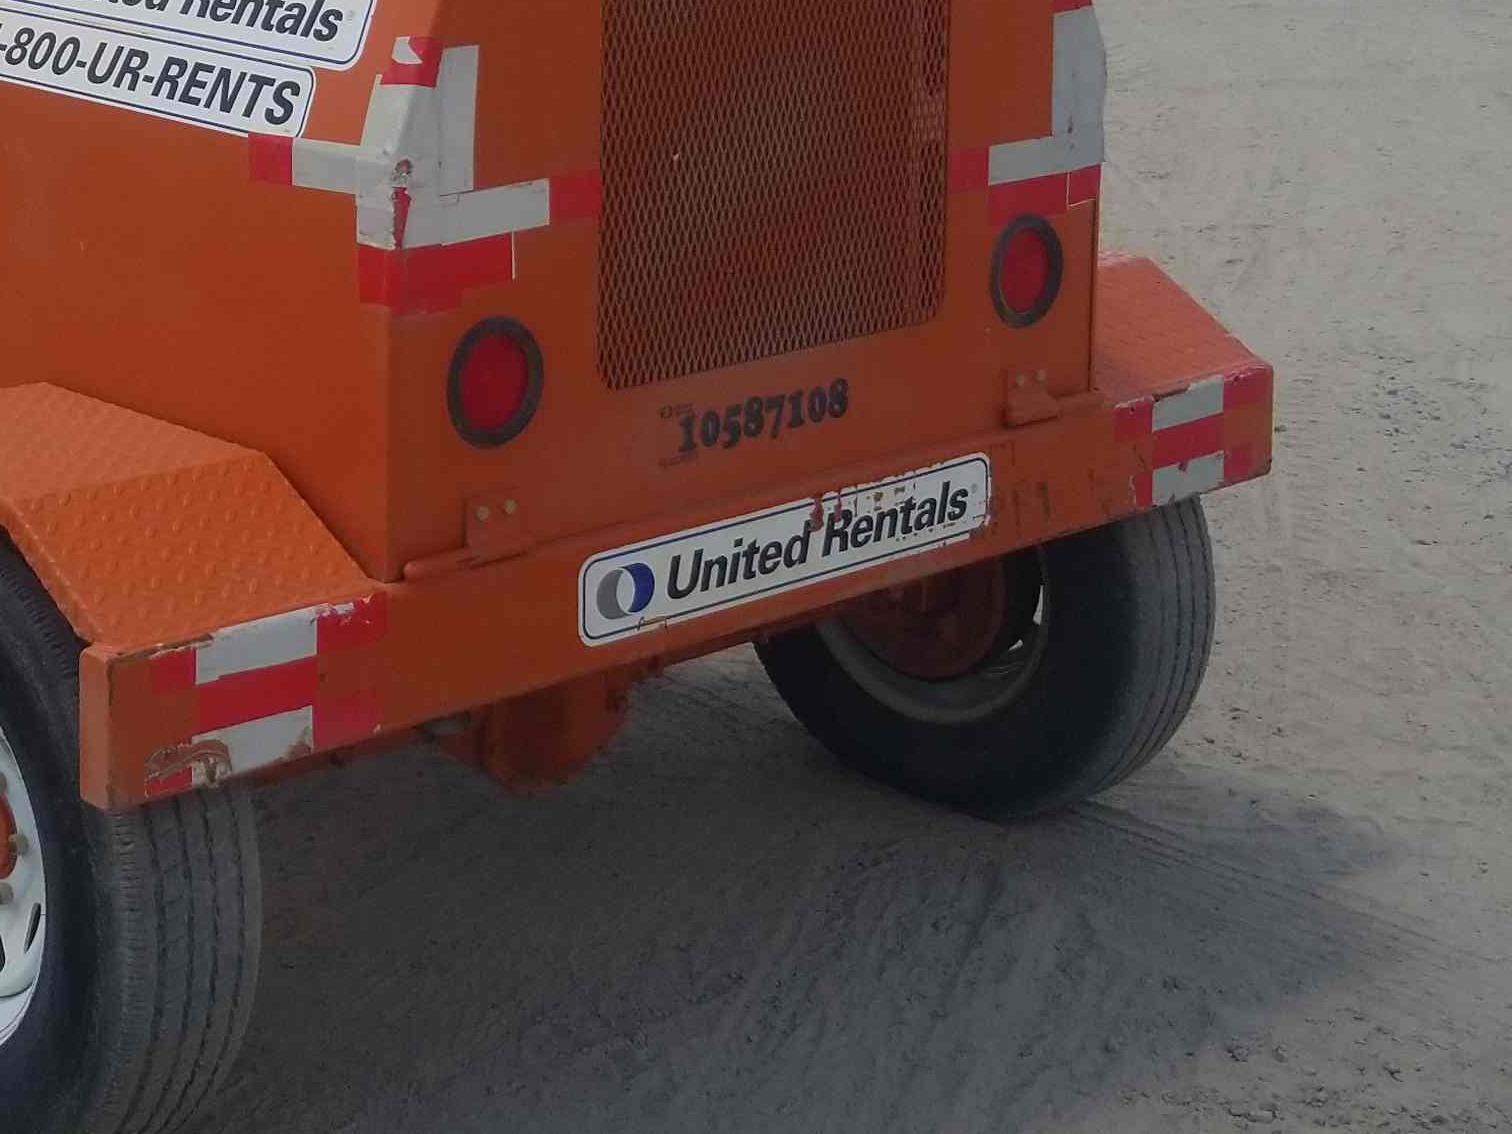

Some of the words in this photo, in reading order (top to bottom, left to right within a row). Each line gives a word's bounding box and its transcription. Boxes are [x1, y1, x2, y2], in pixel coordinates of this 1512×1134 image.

[677, 377, 849, 453] 10587108
[666, 522, 814, 601] United
[821, 480, 969, 559] Rentals
